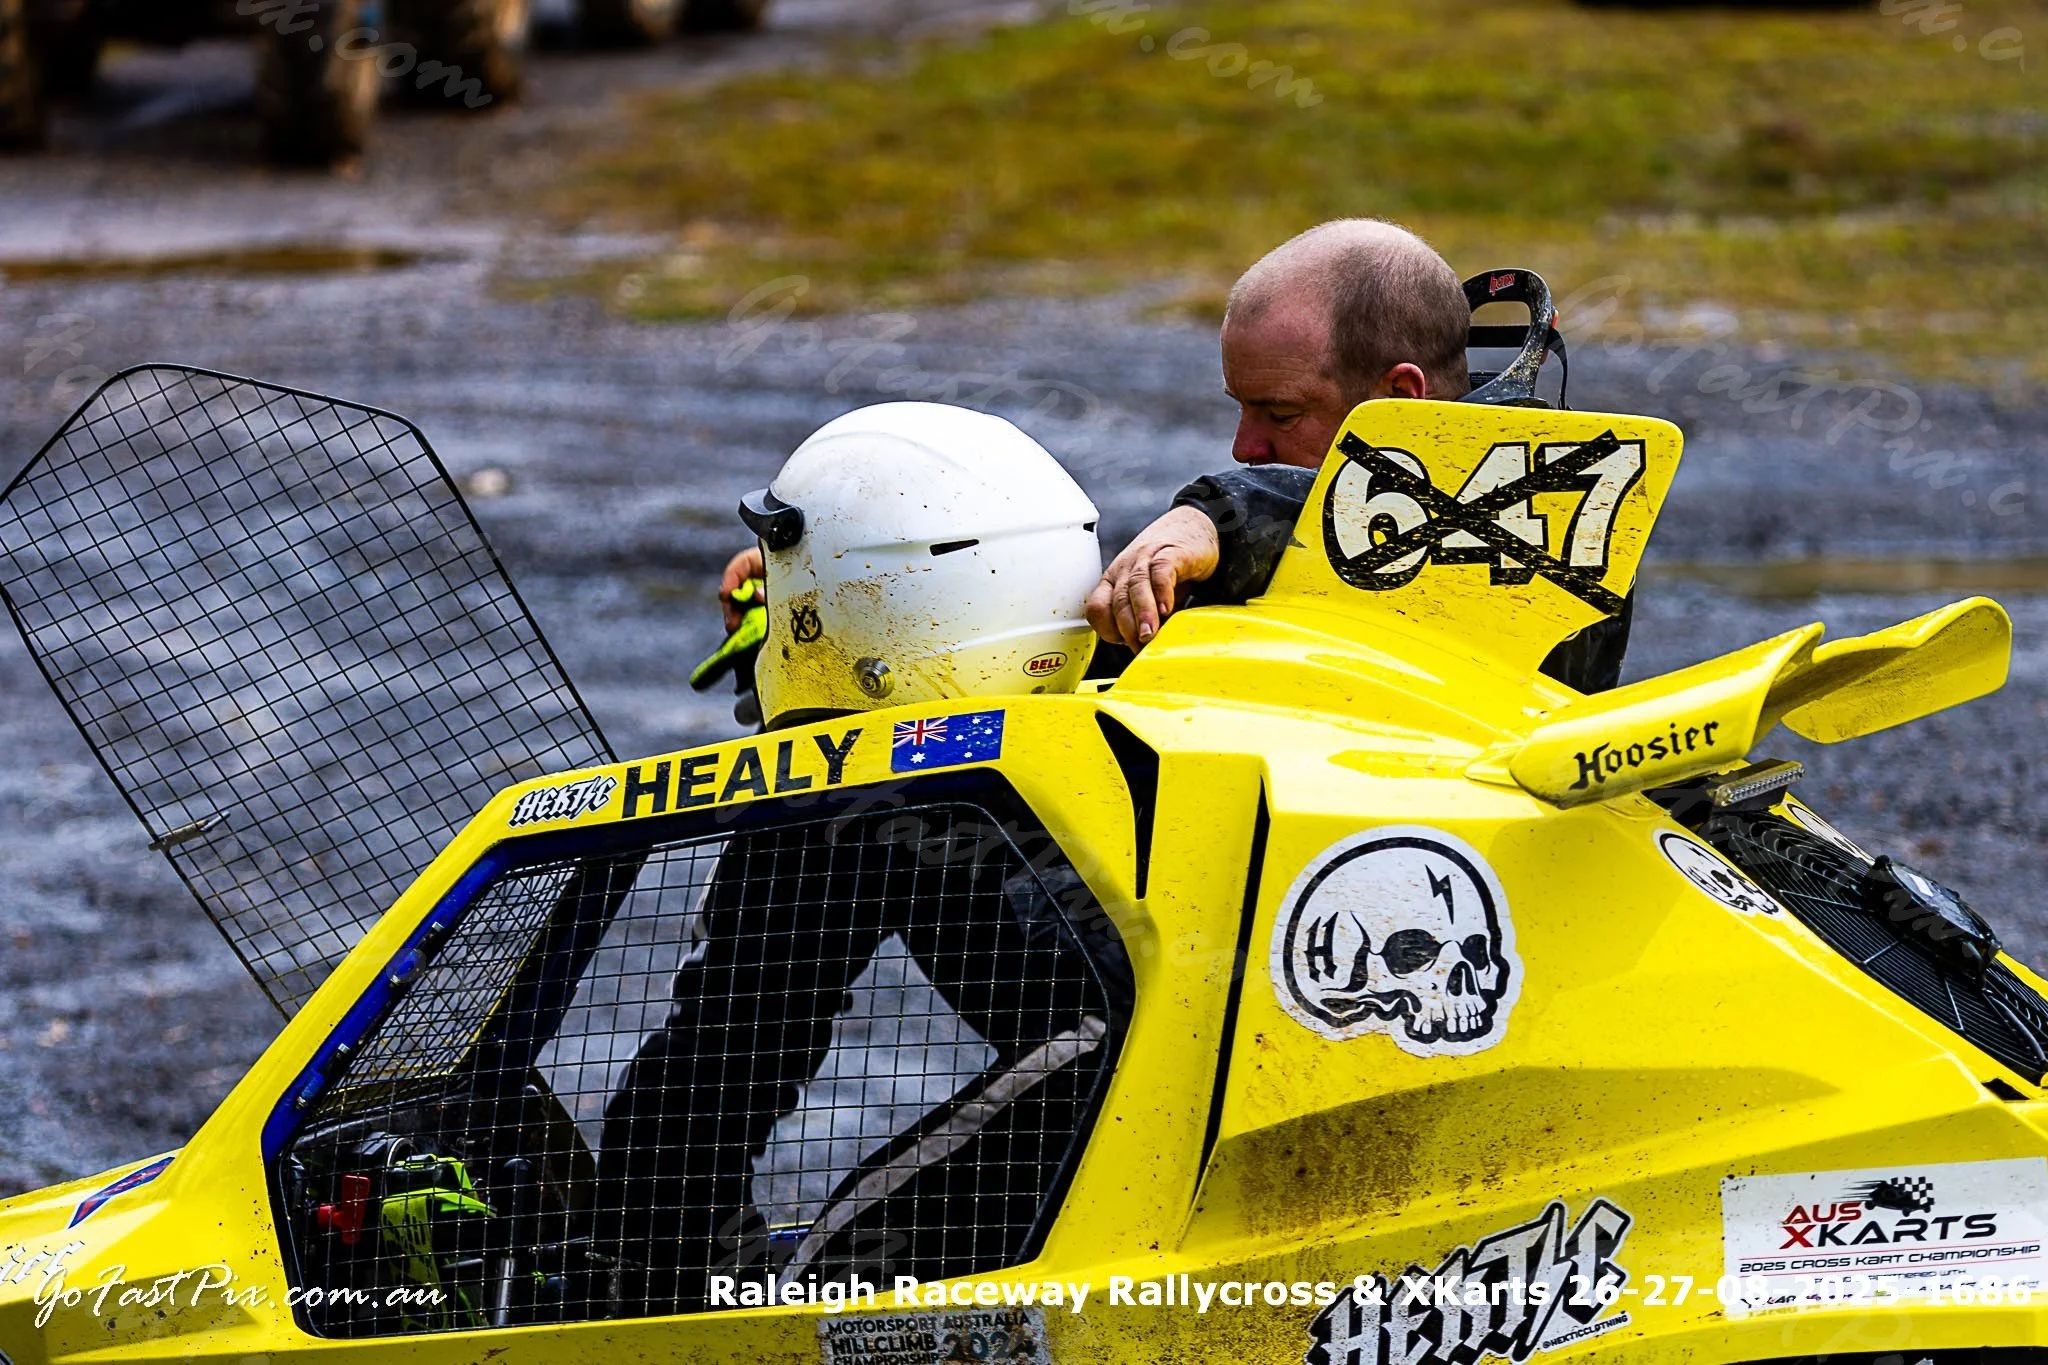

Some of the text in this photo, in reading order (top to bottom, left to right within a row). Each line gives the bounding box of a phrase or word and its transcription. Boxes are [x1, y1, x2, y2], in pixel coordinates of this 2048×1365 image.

[1322, 439, 1647, 591] 647
[1029, 656, 1064, 671] BELL
[1569, 720, 1720, 791] Hoosier
[621, 727, 864, 819] HEALY
[1780, 1201, 1865, 1226] AUS
[1778, 1213, 1998, 1250] XKARTS
[1739, 1261, 1787, 1273] 2025
[1790, 1257, 1851, 1270] CROSS
[827, 1307, 1033, 1335] MOTORSPORT AUSTRALIA
[830, 1332, 938, 1356] HILLCLIMB
